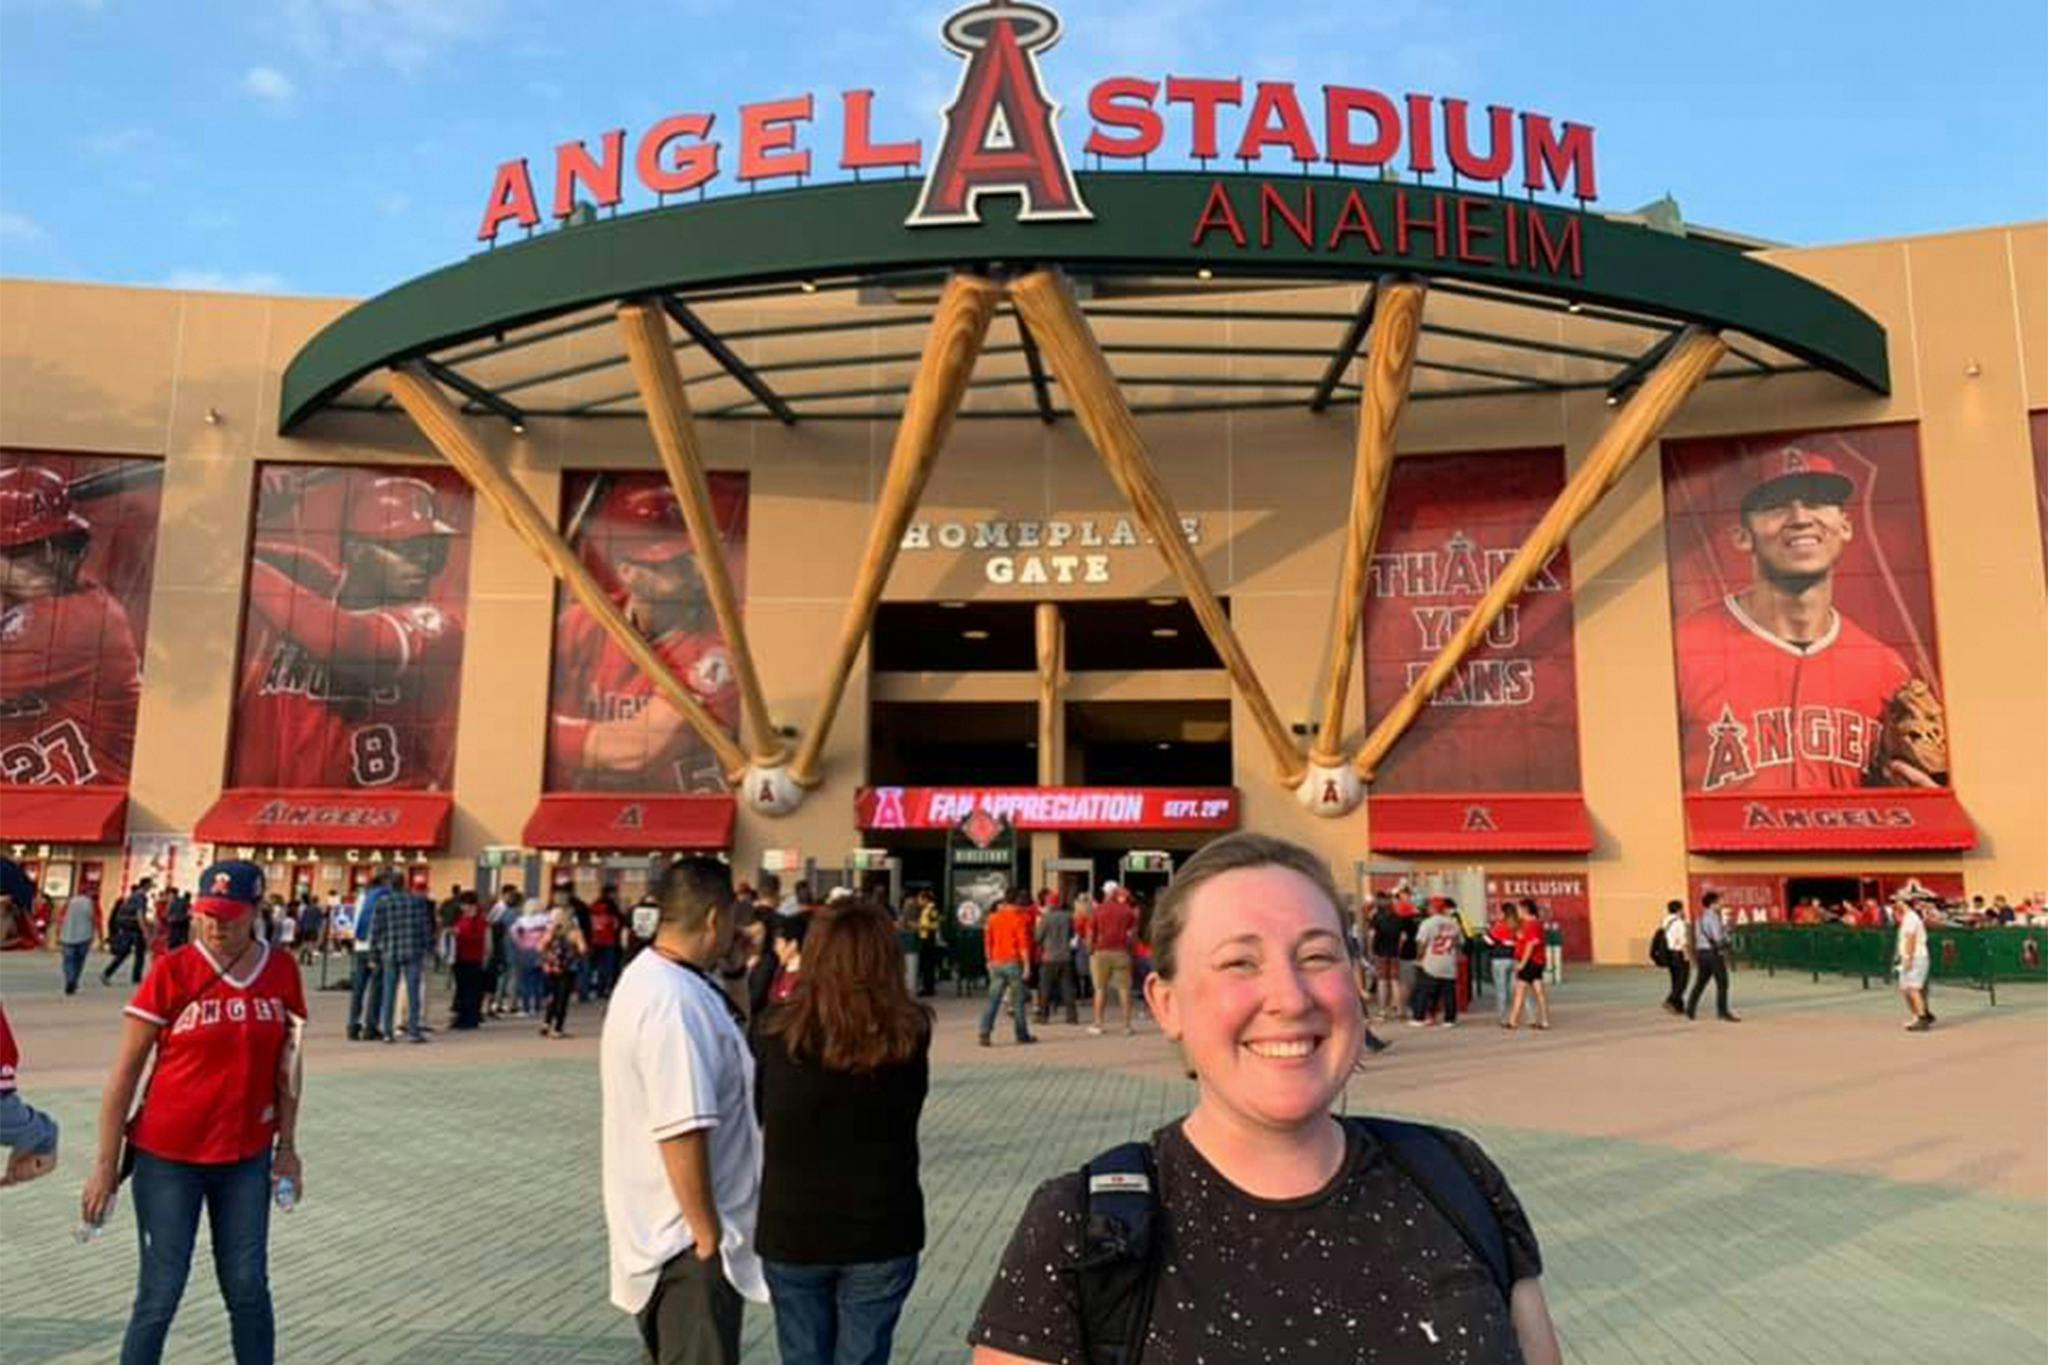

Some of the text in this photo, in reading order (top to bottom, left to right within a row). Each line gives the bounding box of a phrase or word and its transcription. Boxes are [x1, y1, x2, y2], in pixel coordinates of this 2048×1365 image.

[478, 89, 922, 241] ANGEL
[1085, 74, 1597, 201] STADIUM
[1191, 181, 1586, 279] ANAHEIM
[901, 516, 1199, 549] HOMEPLAE
[985, 554, 1109, 584] GATE
[351, 722, 401, 785] 8
[248, 800, 400, 828] ANGELS
[1744, 802, 1915, 830] ANGELS
[236, 847, 428, 863] WILL CALL
[1503, 880, 1582, 895] EXCLUSIVE
